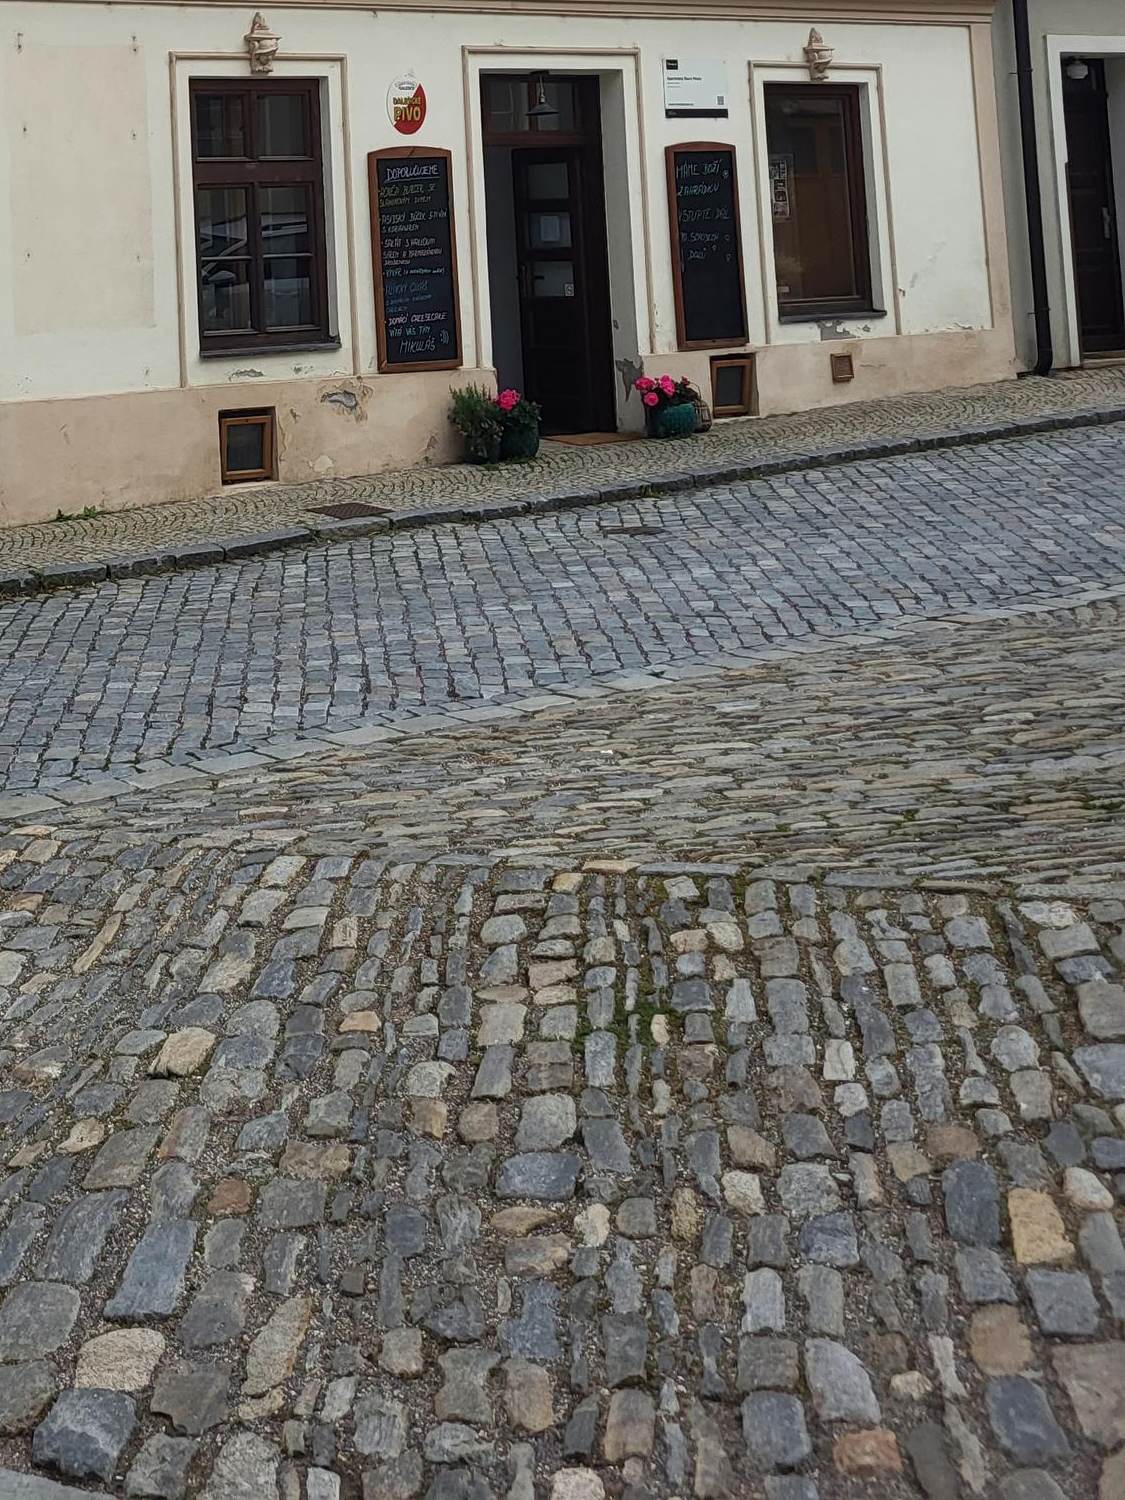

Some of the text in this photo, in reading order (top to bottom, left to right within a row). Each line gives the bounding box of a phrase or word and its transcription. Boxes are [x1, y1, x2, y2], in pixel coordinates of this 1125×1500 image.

[393, 106, 421, 122] PIVO
[386, 164, 439, 181] DOPORUČUJEME
[399, 336, 436, 354] MIKULÁŠ
